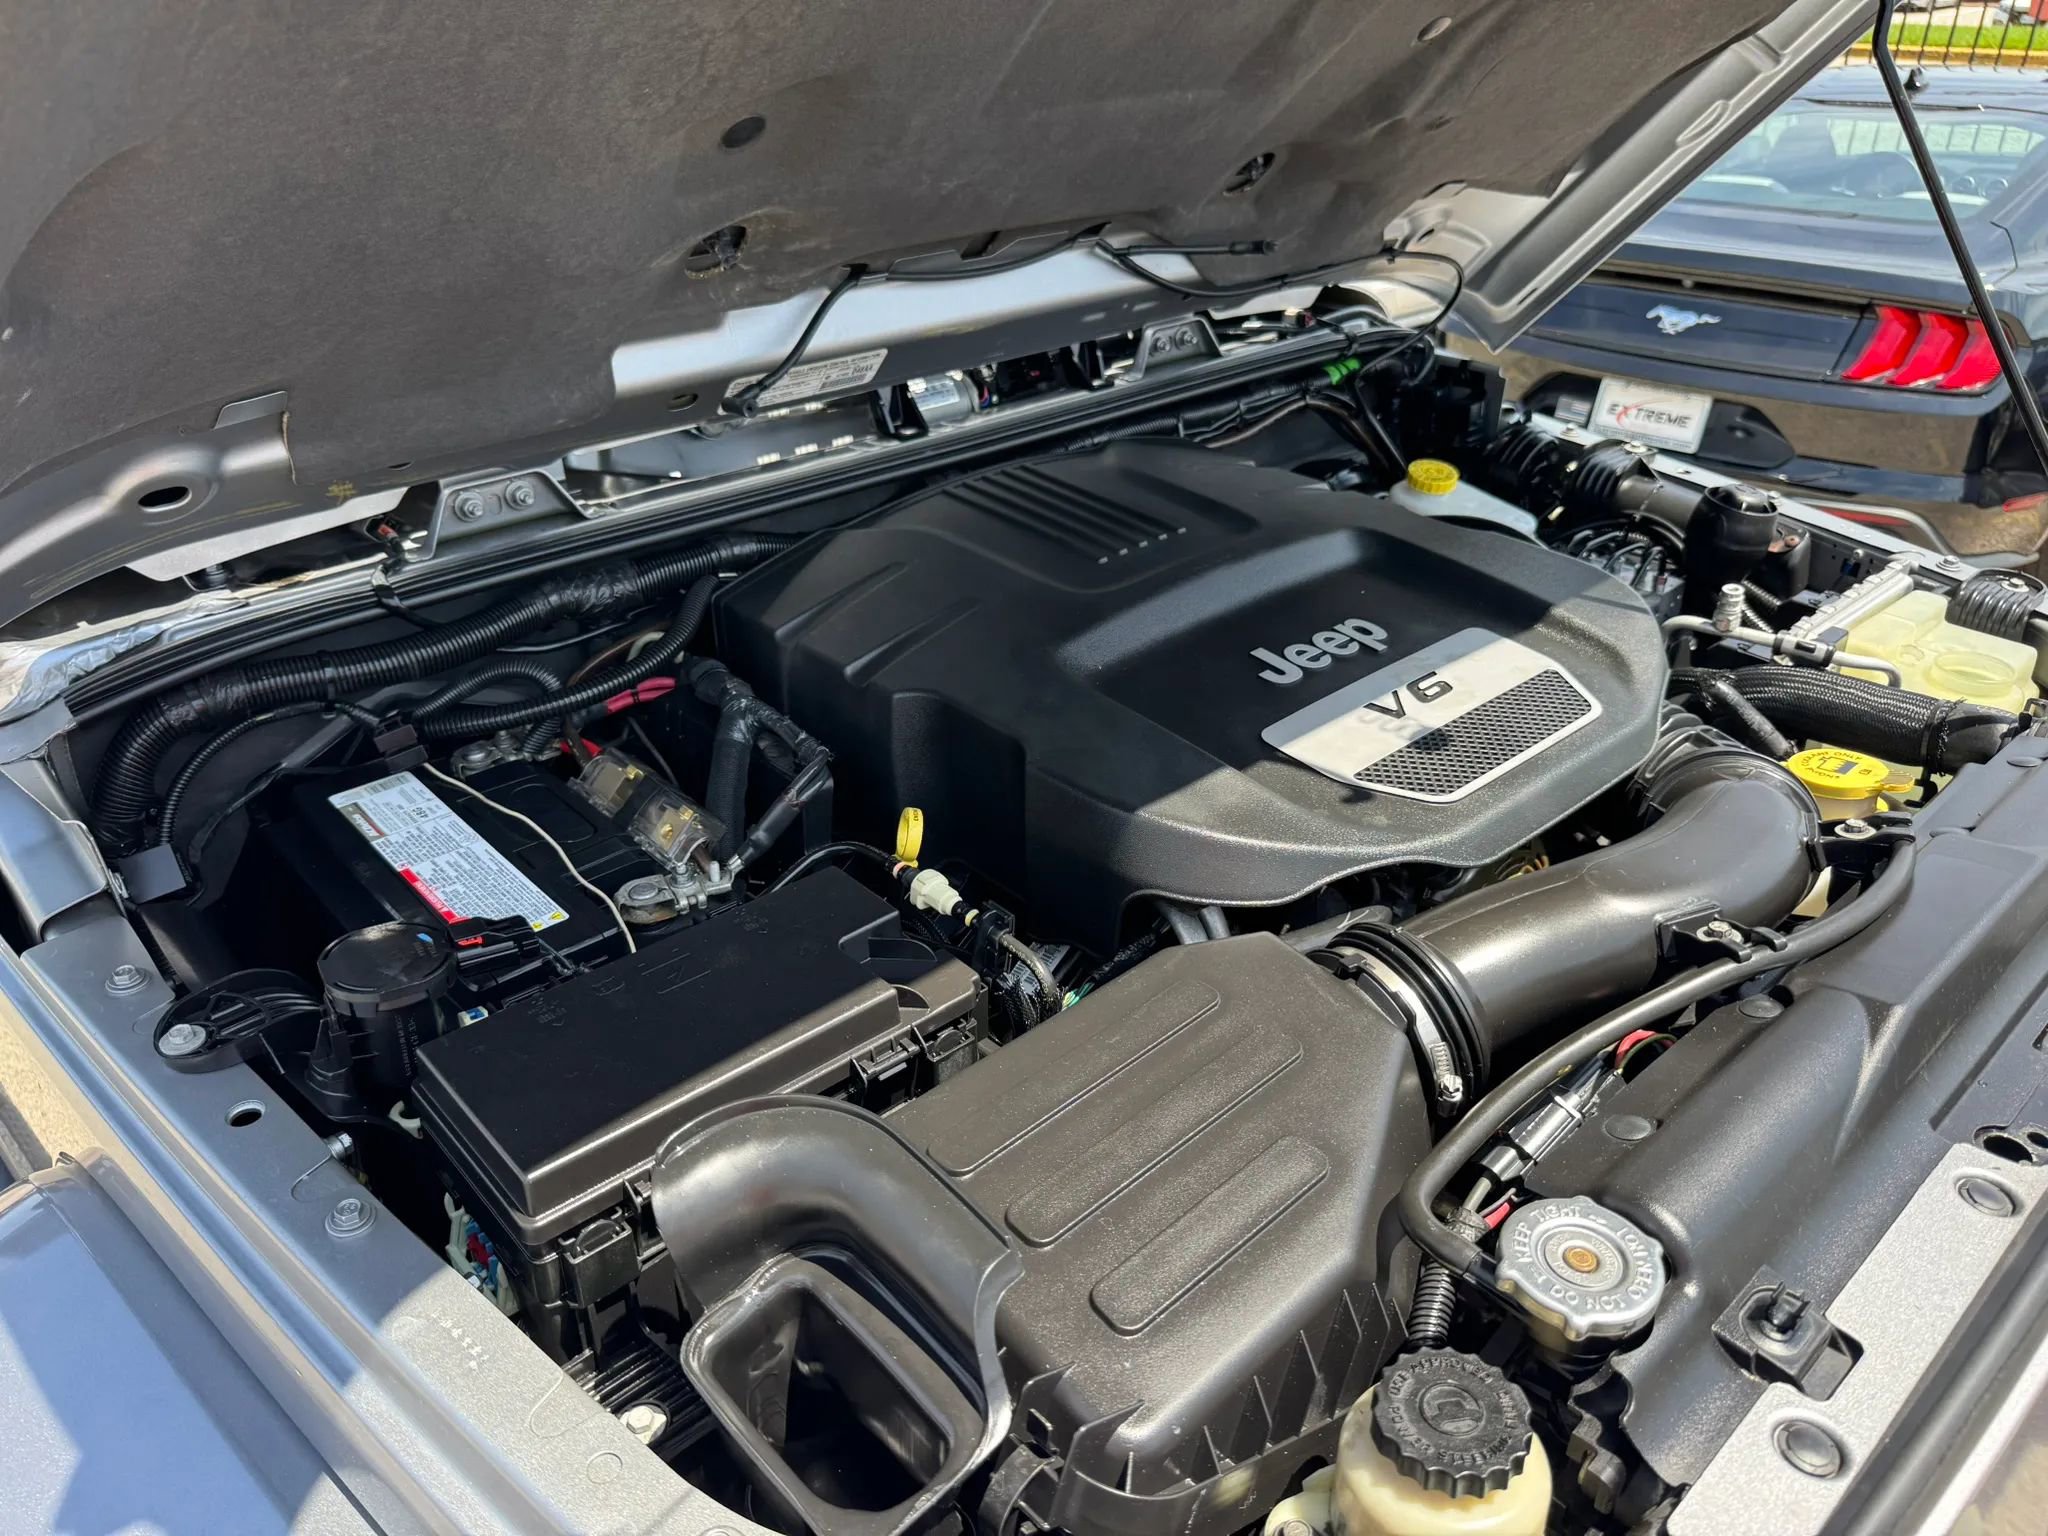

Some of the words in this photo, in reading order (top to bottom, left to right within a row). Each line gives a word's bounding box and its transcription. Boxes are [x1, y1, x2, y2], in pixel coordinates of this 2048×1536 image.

[1606, 402, 1692, 428] EXTREME
[1250, 618, 1388, 684] Jeep
[1363, 671, 1453, 719] V6
[1834, 751, 1863, 761] ONLY
[1513, 1222, 1533, 1263] KEEP
[1530, 1206, 1581, 1223] TIGHT
[1550, 1285, 1579, 1305] DO
[1586, 1294, 1627, 1310] NOT
[1626, 1260, 1656, 1299] OPEN
[1388, 1370, 1412, 1397] USE
[1410, 1356, 1494, 1384] APPROVED
